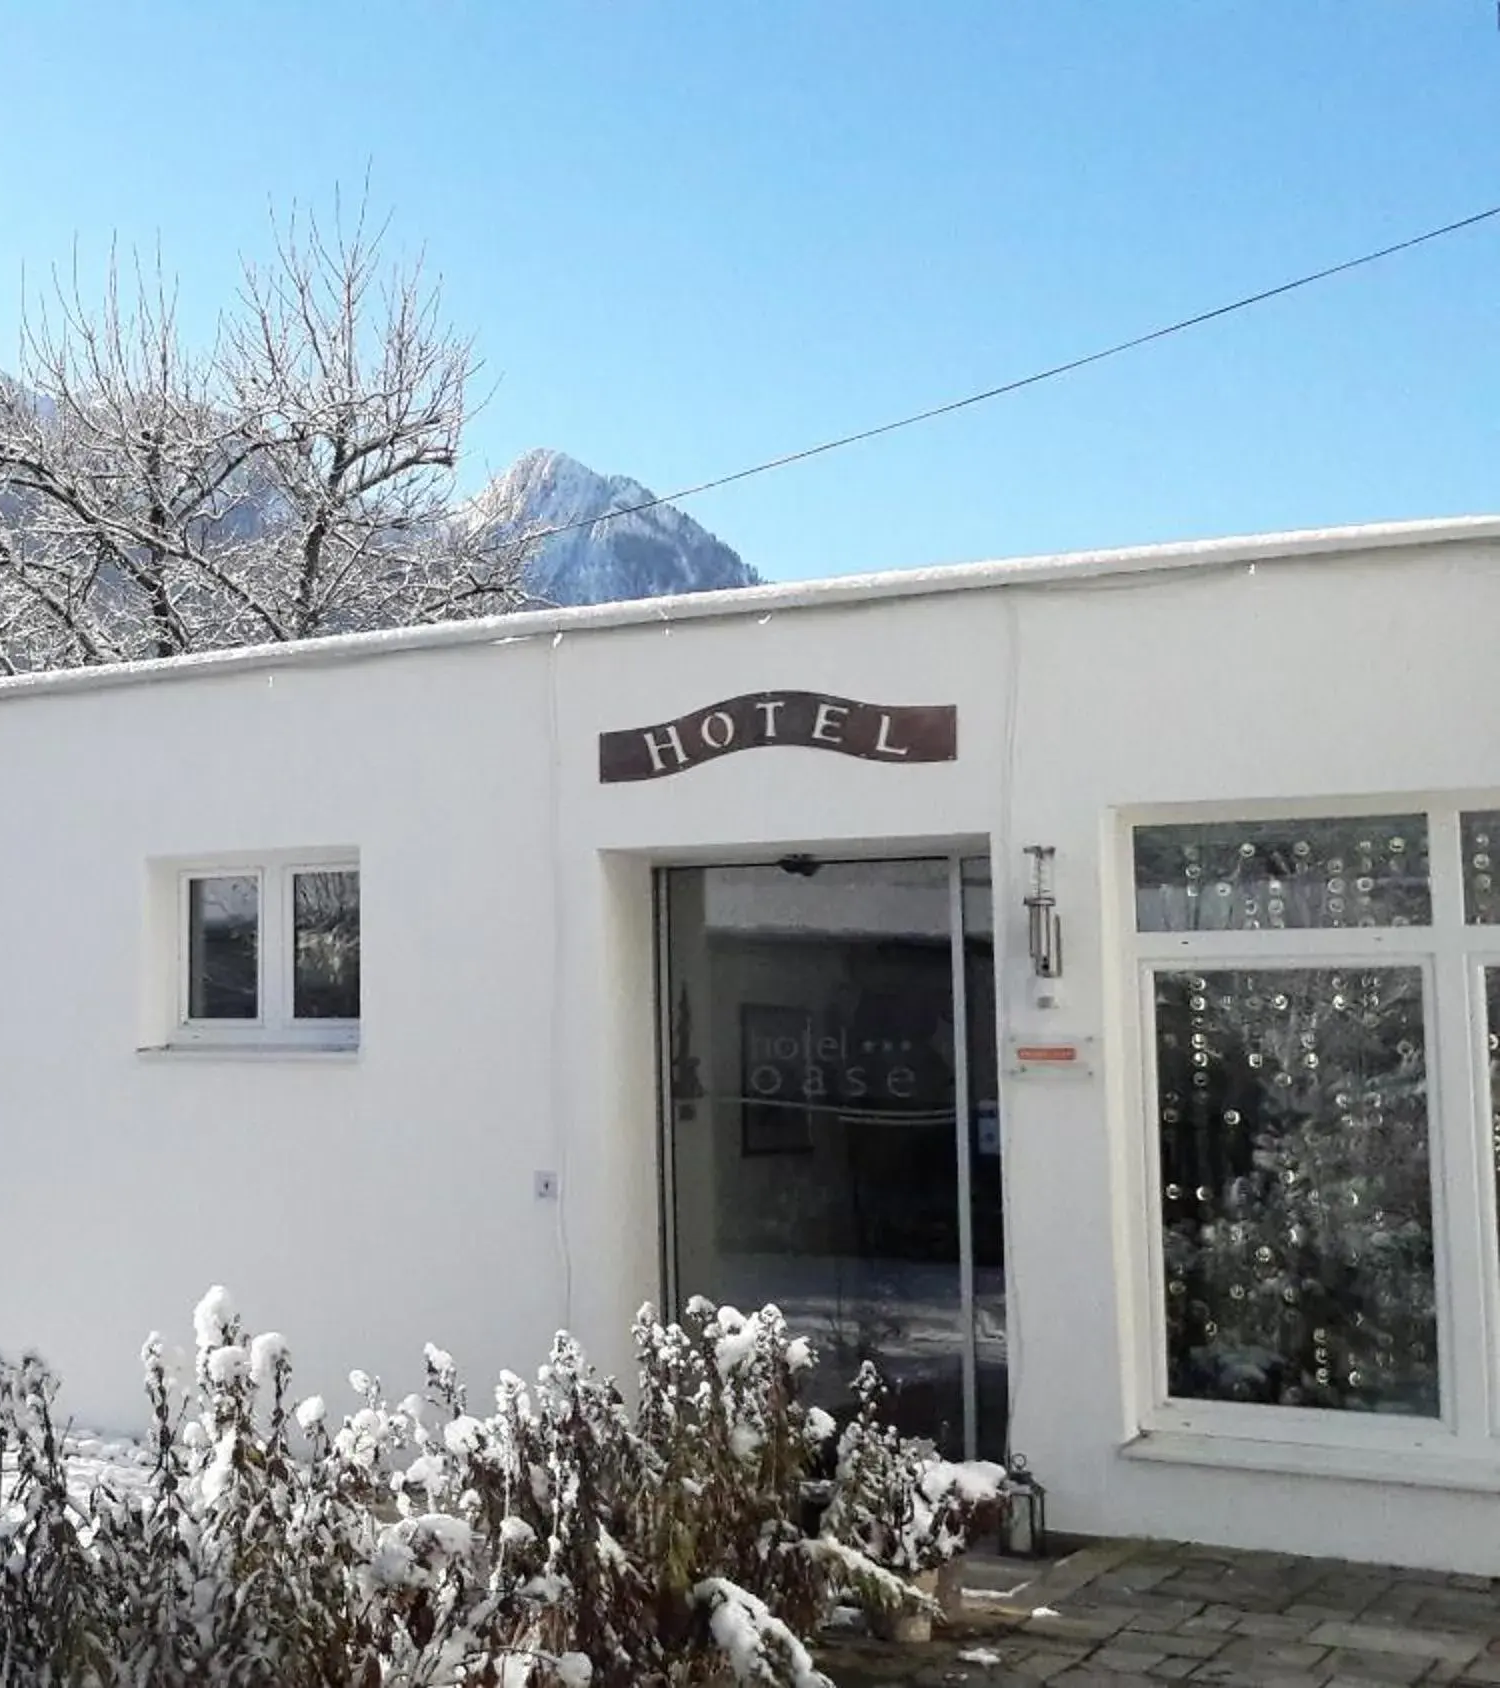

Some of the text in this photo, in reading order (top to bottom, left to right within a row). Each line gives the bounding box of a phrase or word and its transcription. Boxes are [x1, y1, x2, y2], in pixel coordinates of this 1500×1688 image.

[643, 701, 909, 770] HOTEL
[750, 1023, 847, 1061] hotel
[750, 1064, 916, 1097] oase
